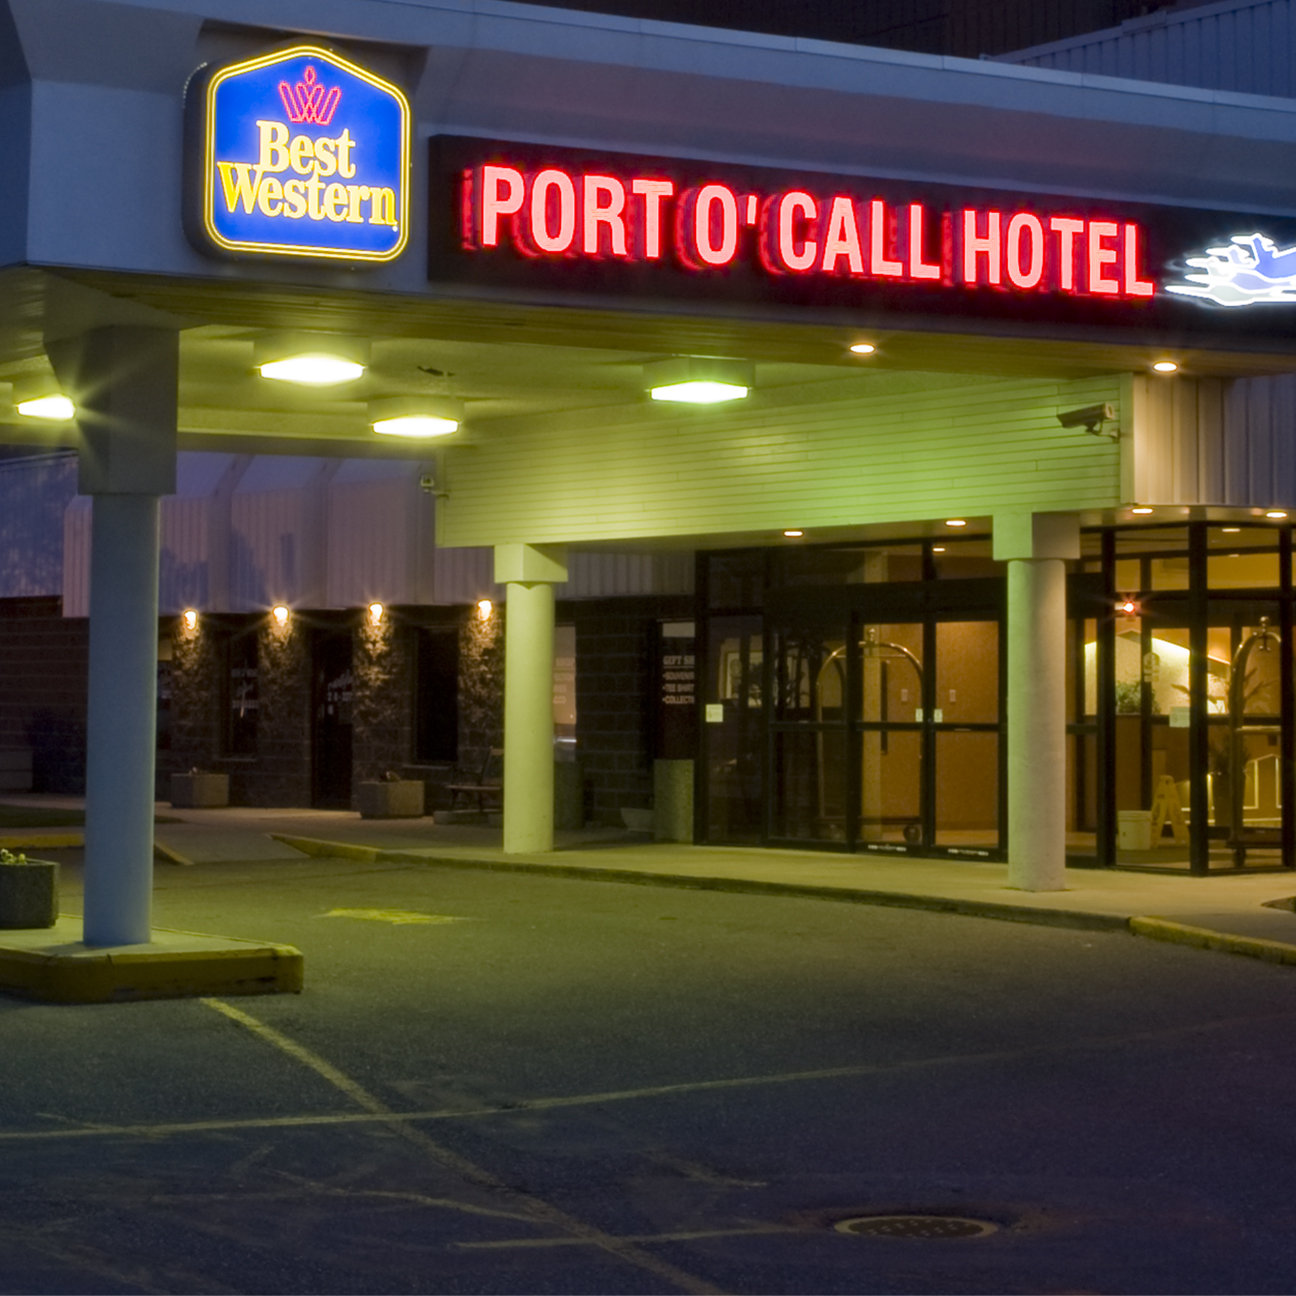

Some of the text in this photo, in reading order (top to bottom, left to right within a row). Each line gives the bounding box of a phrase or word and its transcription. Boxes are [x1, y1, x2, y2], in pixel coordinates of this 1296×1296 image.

[256, 119, 357, 179] Best
[216, 160, 399, 227] Western
[480, 164, 674, 259] PORT
[777, 191, 941, 279] CALL
[962, 208, 1155, 298] HOTEL
